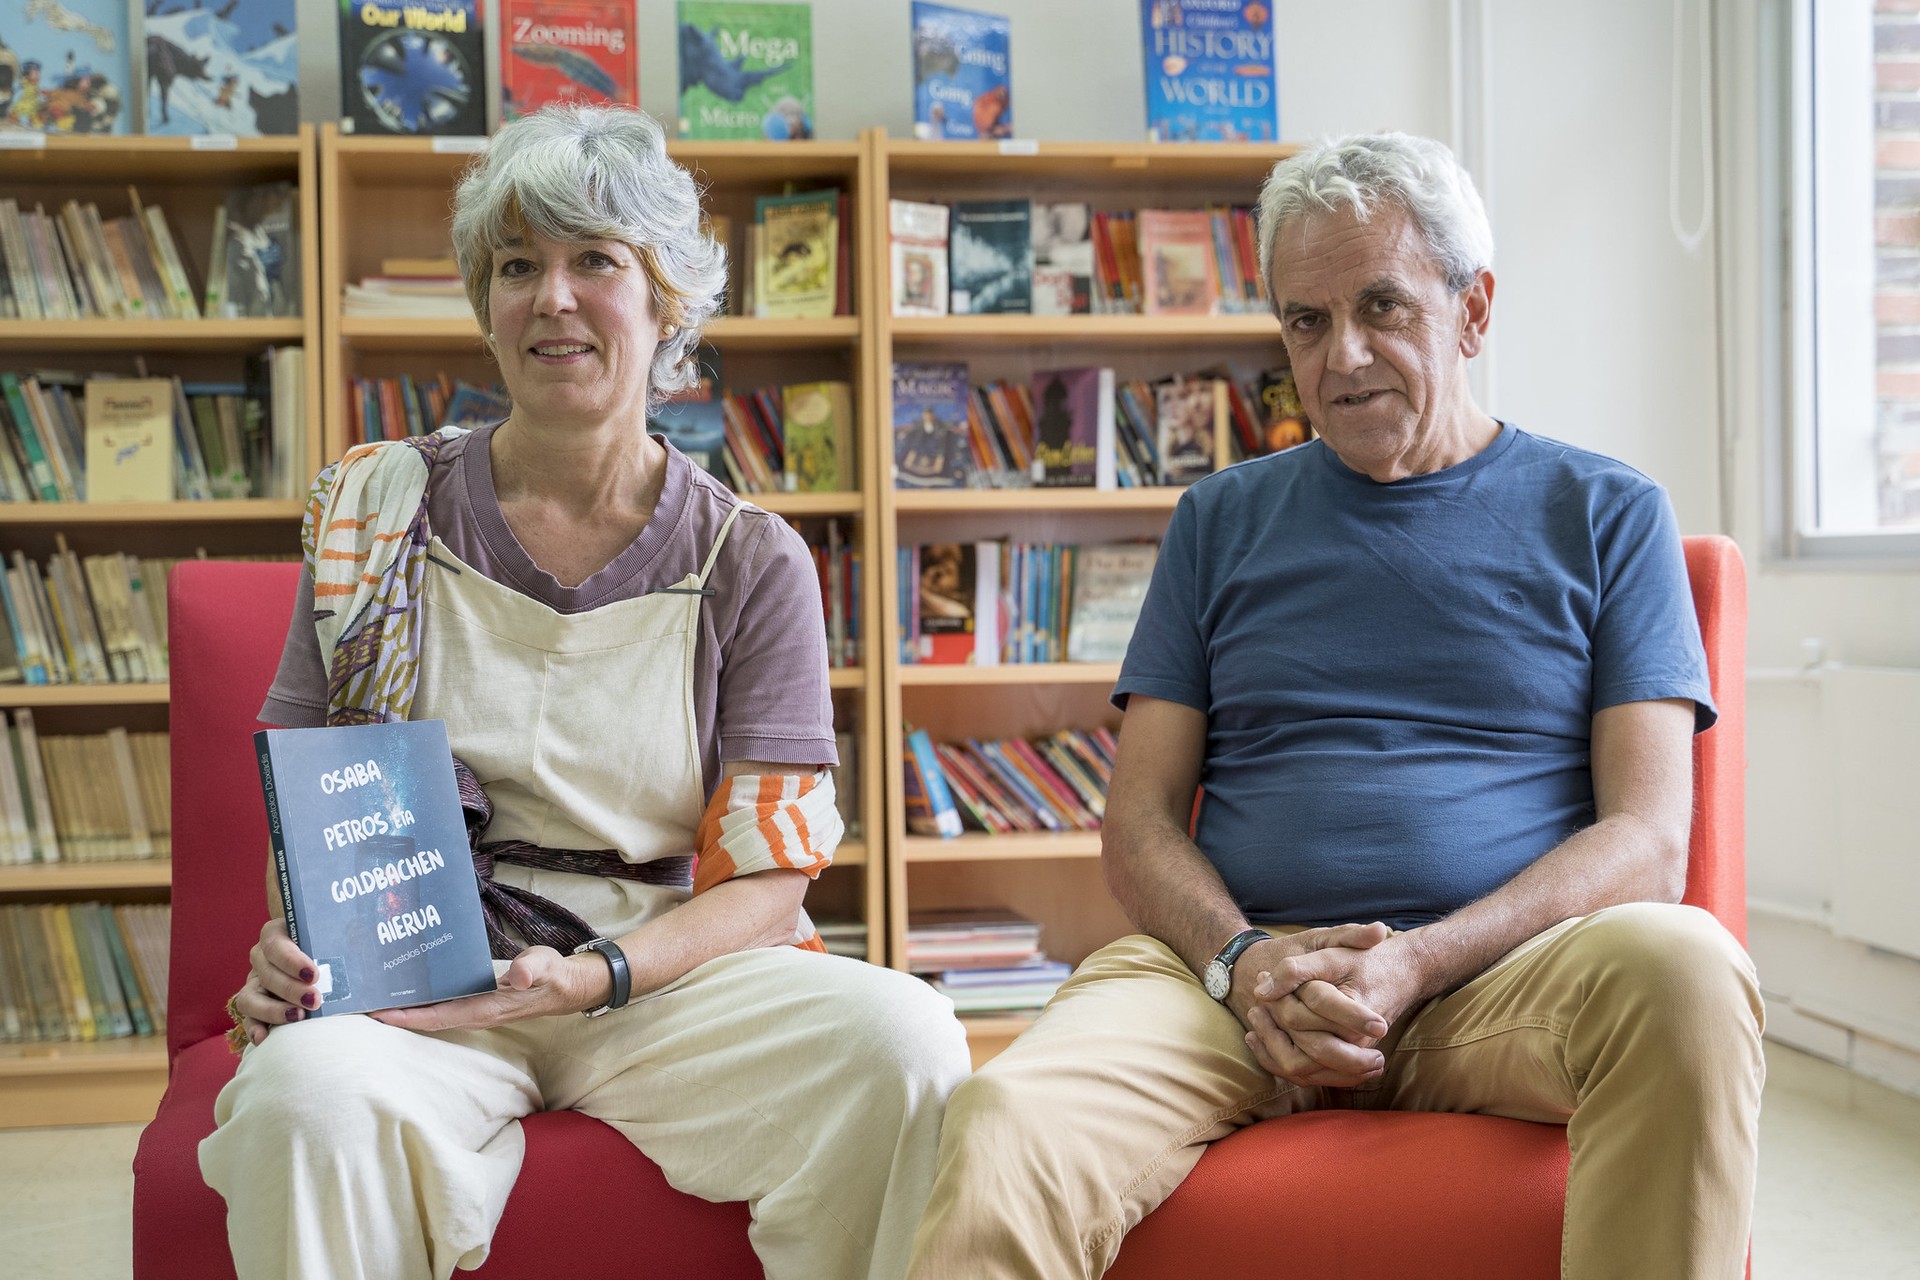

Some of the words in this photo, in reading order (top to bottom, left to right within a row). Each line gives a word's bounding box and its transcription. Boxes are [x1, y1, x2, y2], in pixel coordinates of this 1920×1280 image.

[361, 3, 400, 27] Our
[402, 6, 467, 33] World
[512, 16, 625, 55] Zooming
[719, 29, 799, 68] Mega
[955, 40, 1006, 76] Going
[1154, 29, 1271, 60] HISTORY
[928, 79, 972, 110] Going
[1160, 77, 1269, 108] WORLD
[700, 106, 759, 128] Micro
[261, 753, 274, 791] Doxiadis
[320, 759, 382, 795] OSABA
[270, 791, 281, 834] Apostolos
[323, 812, 389, 852] PETROS
[392, 809, 416, 830] ETA
[281, 872, 293, 910] GOLDBACHEN
[331, 848, 445, 904] GOLDBACHEN
[288, 911, 296, 922] ETA
[376, 904, 442, 946] AIERUA
[383, 948, 421, 971] Apostolos
[420, 932, 453, 953] Doxiadis
